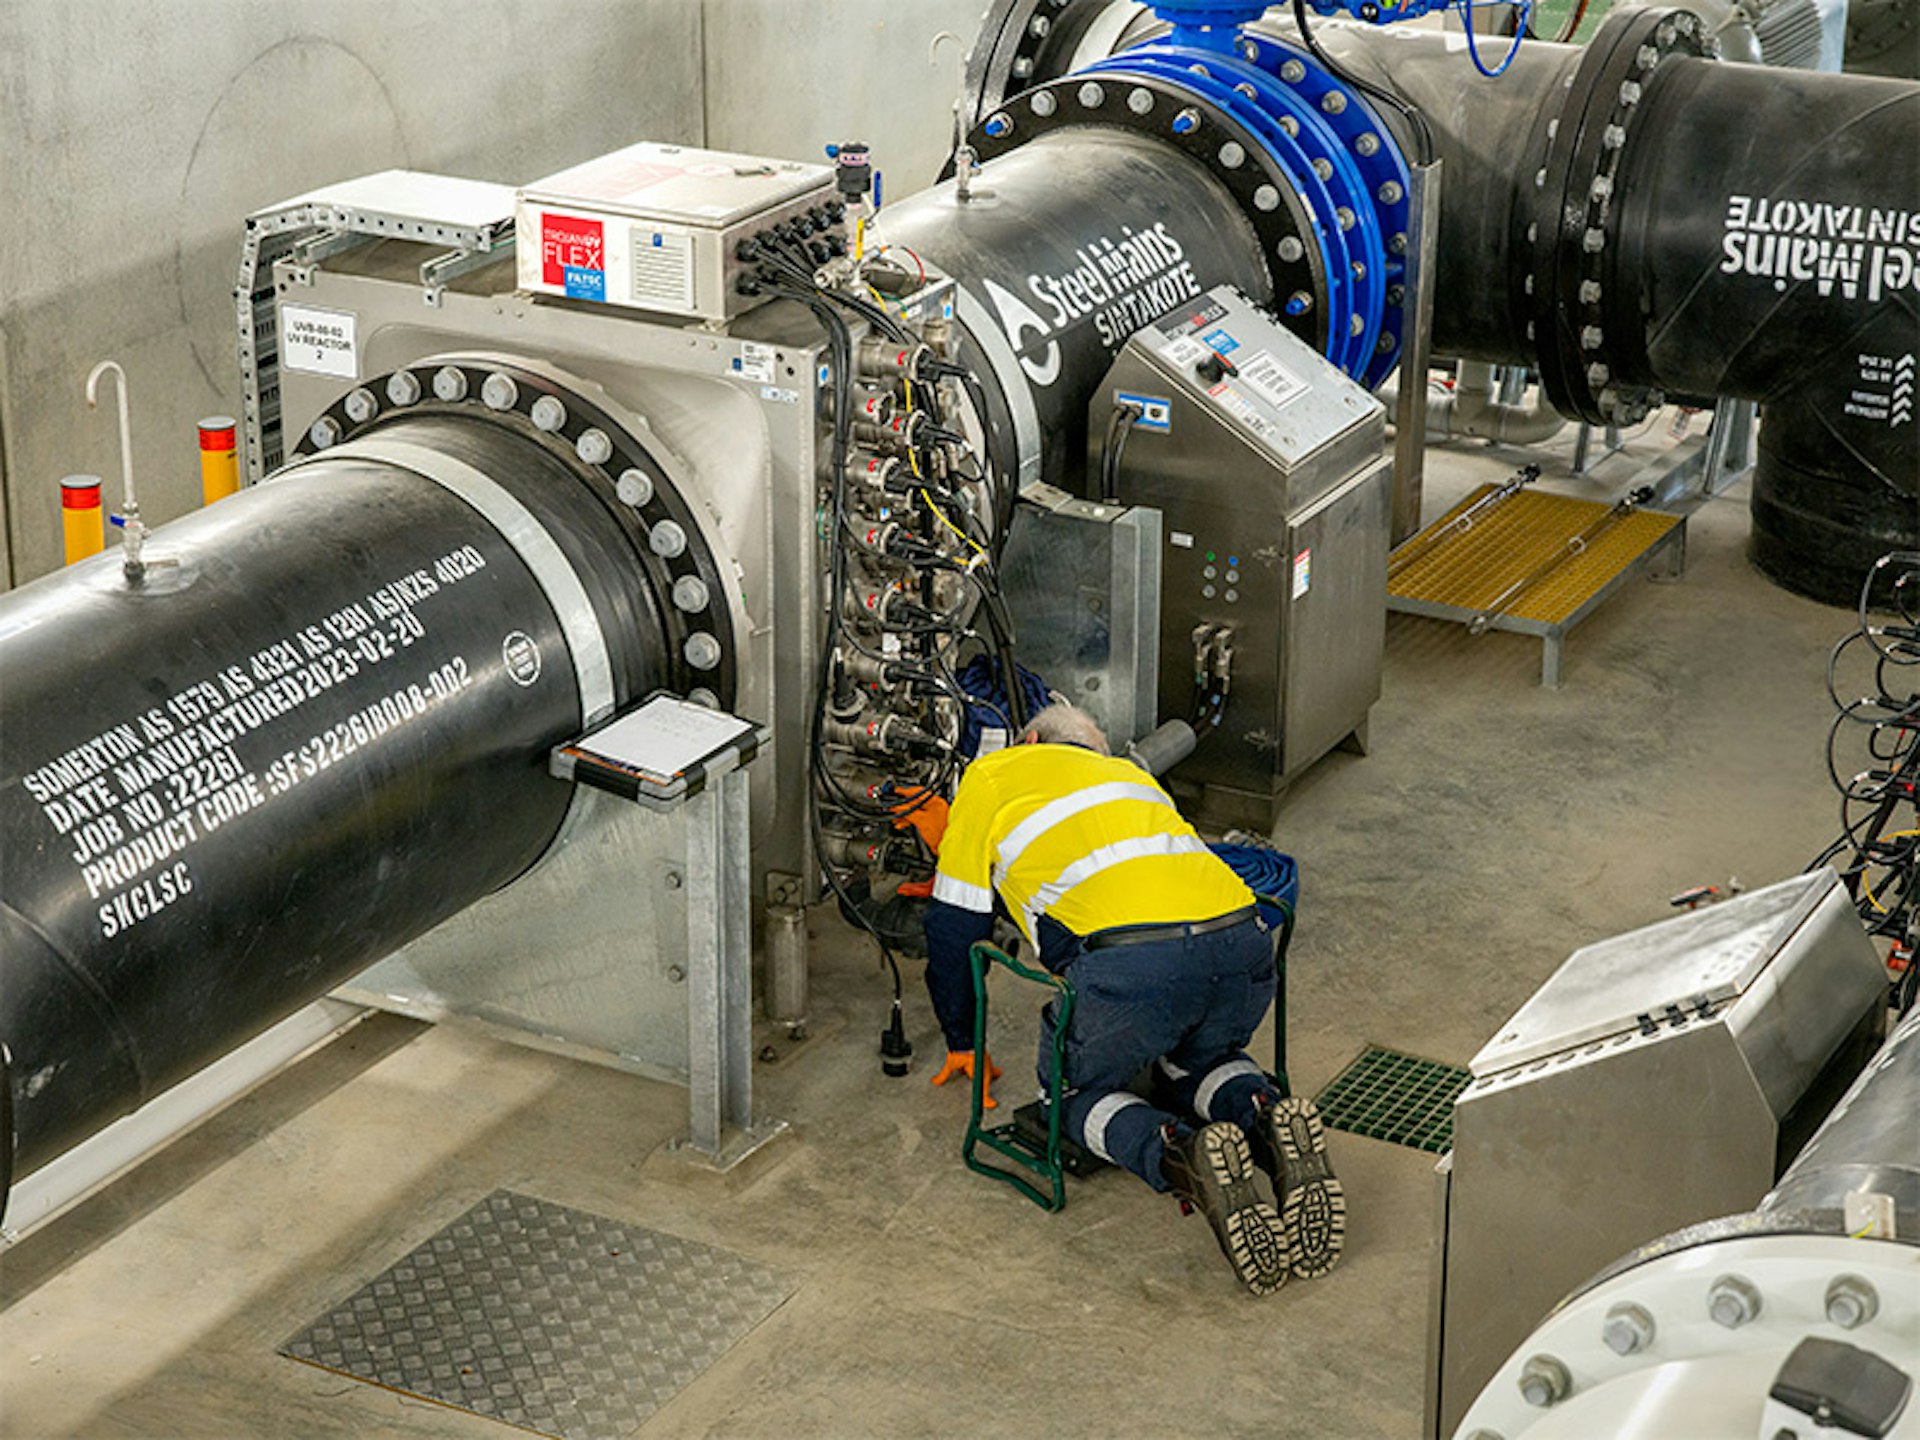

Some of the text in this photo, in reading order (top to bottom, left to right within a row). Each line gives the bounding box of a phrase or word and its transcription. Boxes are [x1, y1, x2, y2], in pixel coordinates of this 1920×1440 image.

[544, 241, 602, 271] FLEX
[1724, 195, 1920, 246] SINTAKOTE
[1027, 250, 1115, 328] Steel
[1087, 222, 1183, 294] Mains
[1720, 231, 1865, 299] Mains
[1095, 261, 1201, 347] SINTAKOTE
[303, 334, 352, 351] REACTOR
[23, 724, 145, 803] SOMERTON
[137, 708, 175, 743] AS
[166, 681, 226, 726] 1579
[217, 665, 255, 700] AS
[249, 639, 304, 681] 4321
[296, 625, 333, 658] AS
[366, 569, 440, 621] AS/NZS
[433, 544, 487, 584] 4020
[43, 776, 120, 835] DATE
[72, 814, 125, 866] JOB
[121, 791, 165, 832] NO
[81, 808, 199, 900] PRODUCT
[197, 772, 266, 832] CODE
